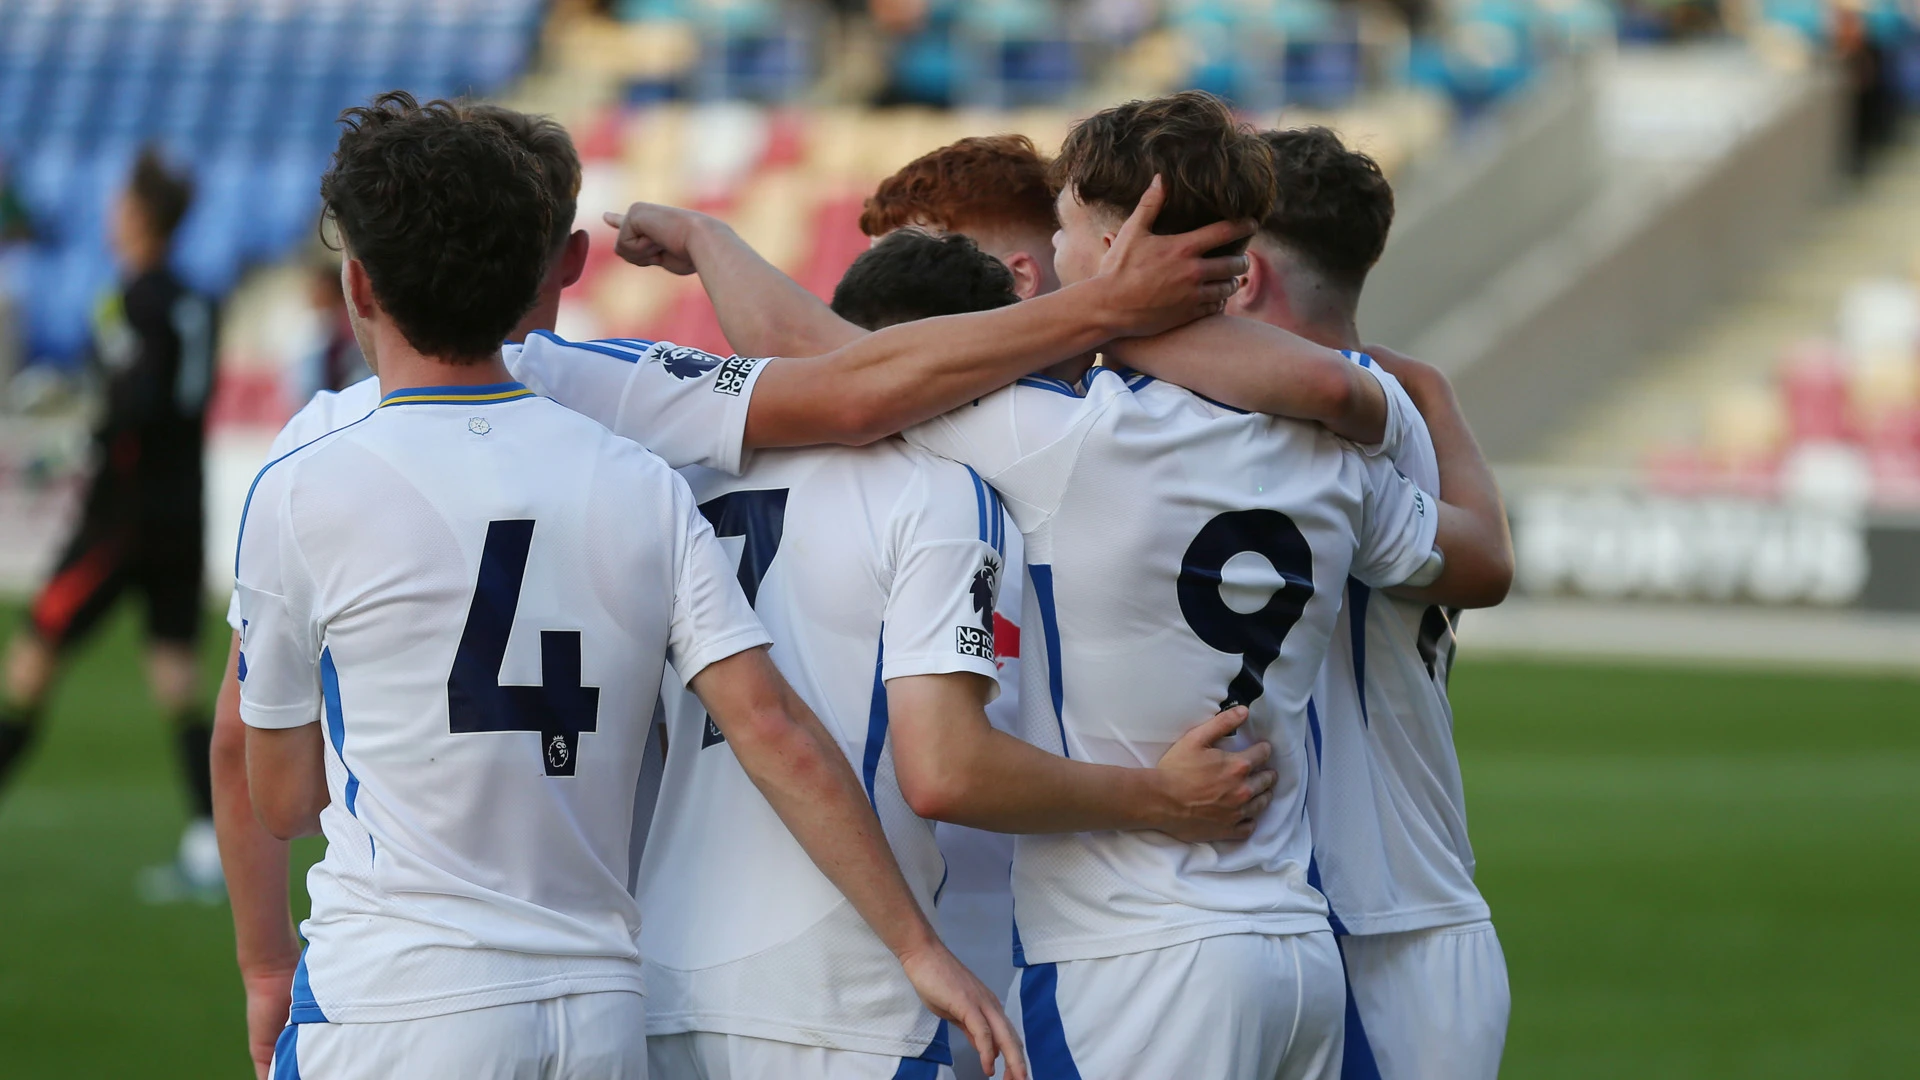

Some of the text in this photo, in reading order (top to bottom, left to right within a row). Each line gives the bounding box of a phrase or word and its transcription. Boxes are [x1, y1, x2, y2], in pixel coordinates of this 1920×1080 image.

[714, 357, 743, 393] No ro
[726, 373, 746, 396] For
[957, 626, 993, 648] No ro
[1176, 508, 1315, 737] 9
[447, 519, 600, 778] 4
[957, 640, 980, 655] For
